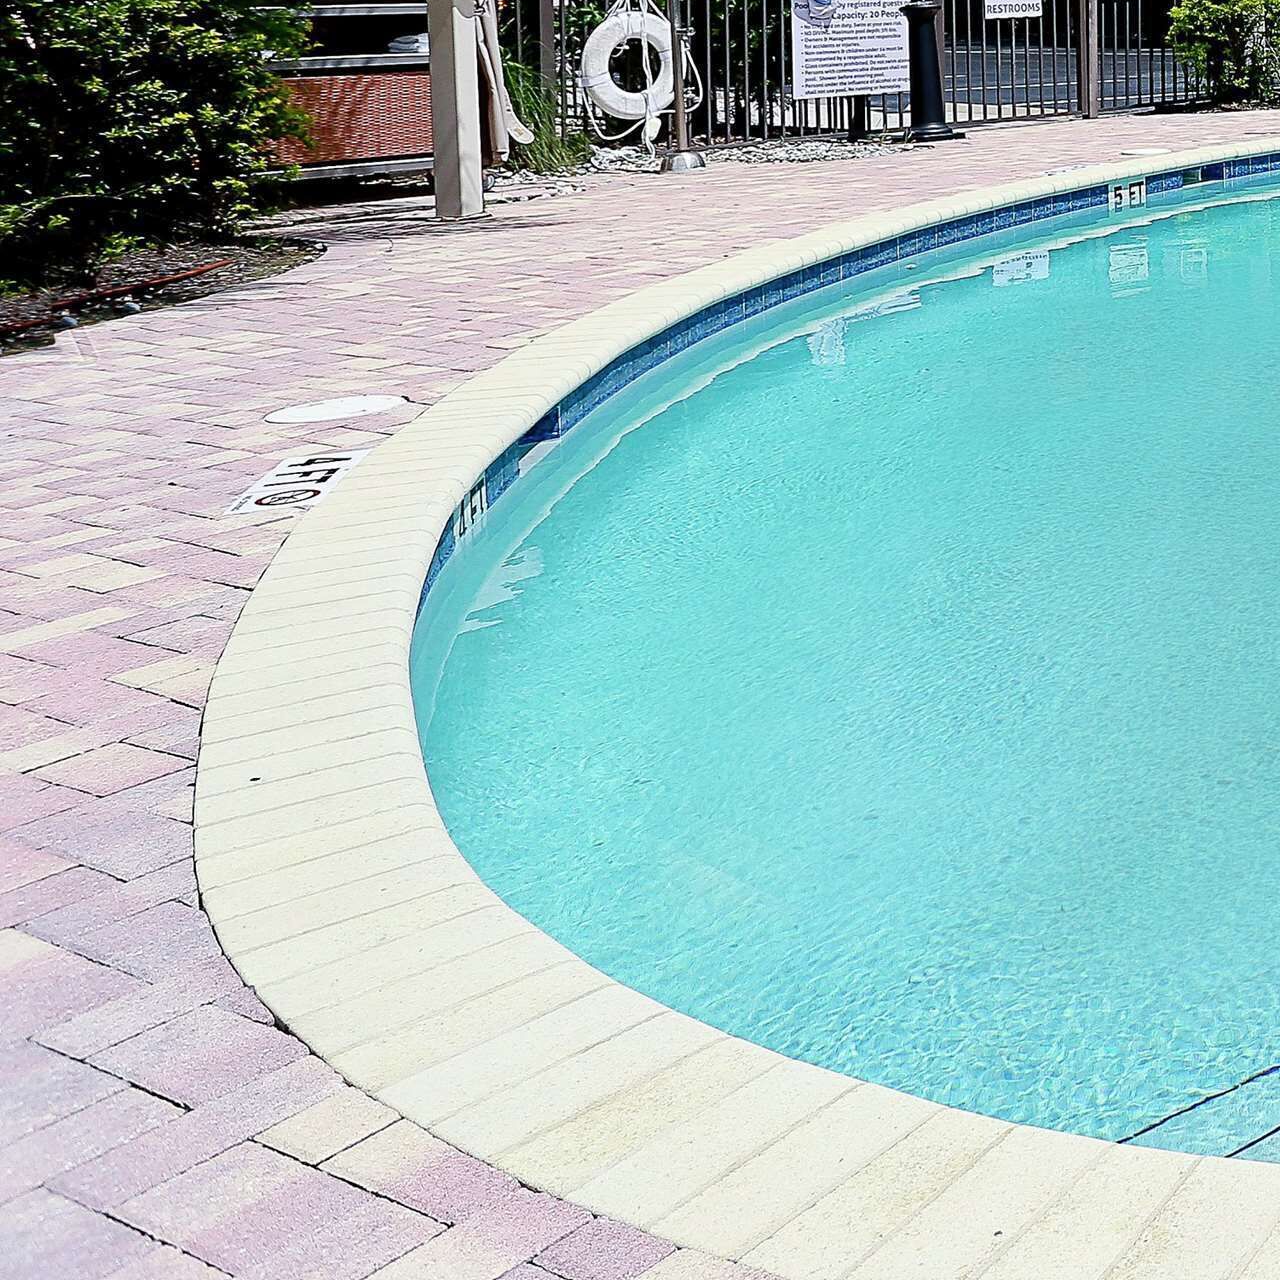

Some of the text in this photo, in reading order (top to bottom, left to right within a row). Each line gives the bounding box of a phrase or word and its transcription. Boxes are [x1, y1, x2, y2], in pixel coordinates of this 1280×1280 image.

[794, 2, 809, 10] Poo
[847, 0, 881, 9] registered
[882, 0, 903, 9] guests
[986, 3, 1041, 14] RESTROOMS
[831, 10, 868, 21] Capacity:
[870, 10, 880, 18] 20
[262, 457, 352, 488] 4 FT
[459, 477, 485, 538] 4 FT
